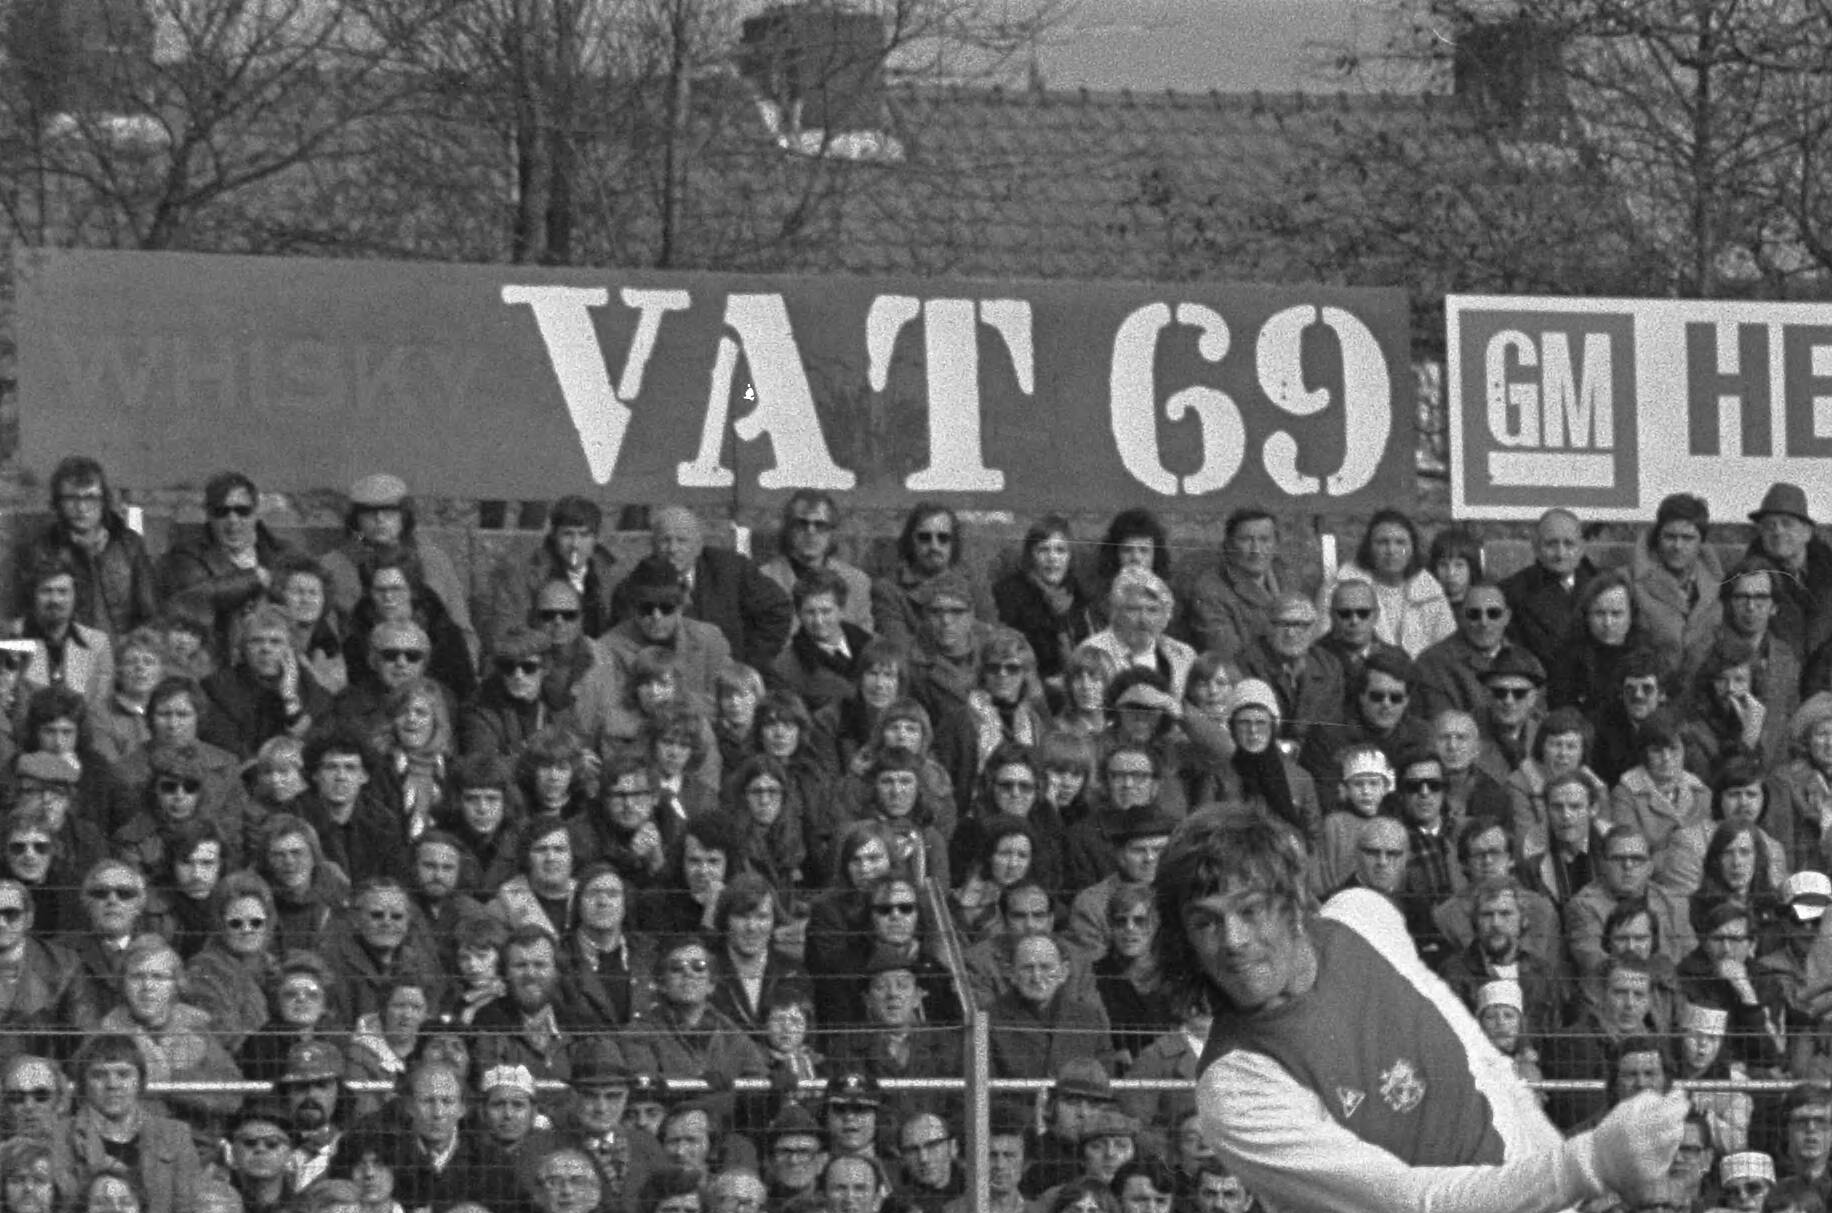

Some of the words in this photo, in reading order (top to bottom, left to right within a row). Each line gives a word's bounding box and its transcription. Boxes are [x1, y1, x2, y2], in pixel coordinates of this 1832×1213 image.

[50, 336, 484, 413] WHISKY
[501, 285, 1034, 491] VAT
[1110, 302, 1393, 496] 69
[1485, 329, 1615, 449] GM
